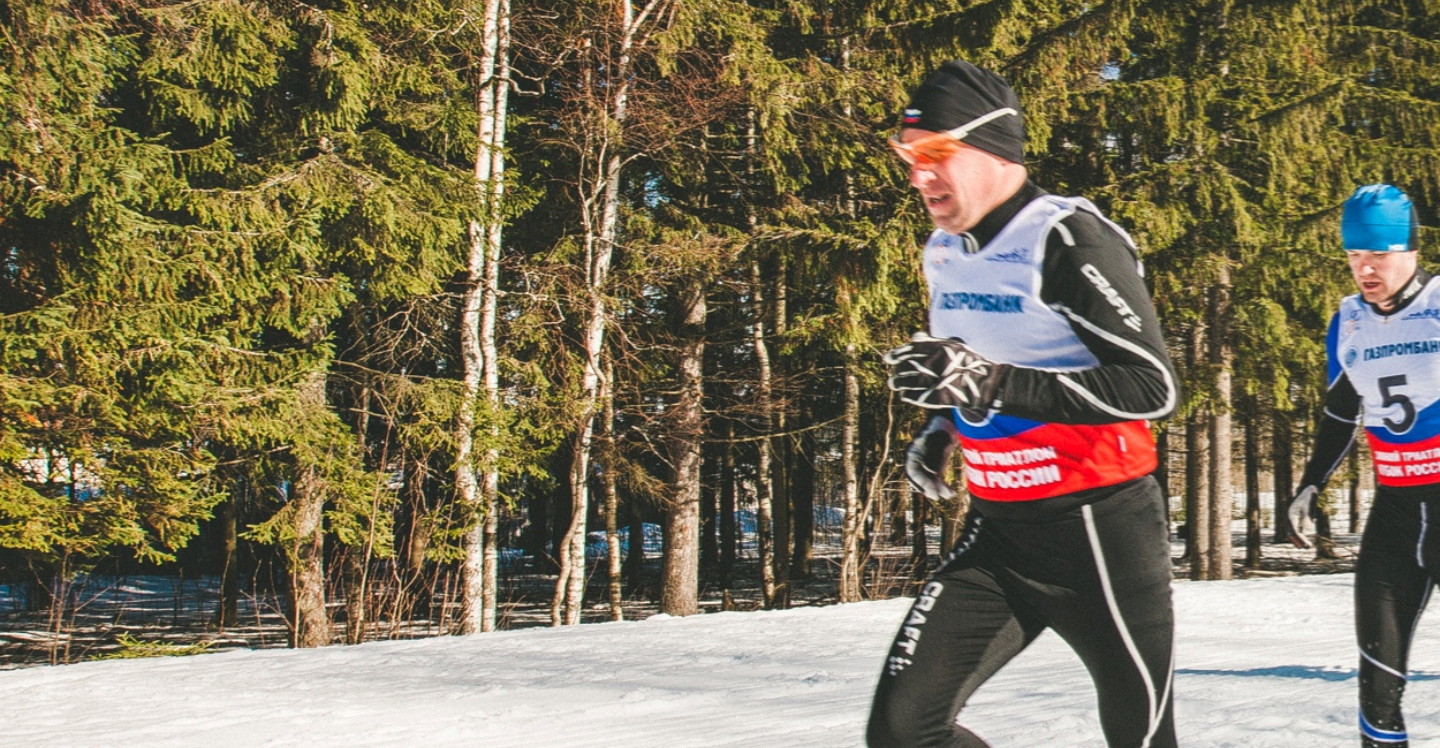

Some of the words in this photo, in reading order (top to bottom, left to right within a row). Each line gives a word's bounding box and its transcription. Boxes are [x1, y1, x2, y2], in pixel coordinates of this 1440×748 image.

[1080, 263, 1141, 329] CRAFT
[1378, 374, 1417, 435] 5
[897, 581, 944, 656] CRAFT
